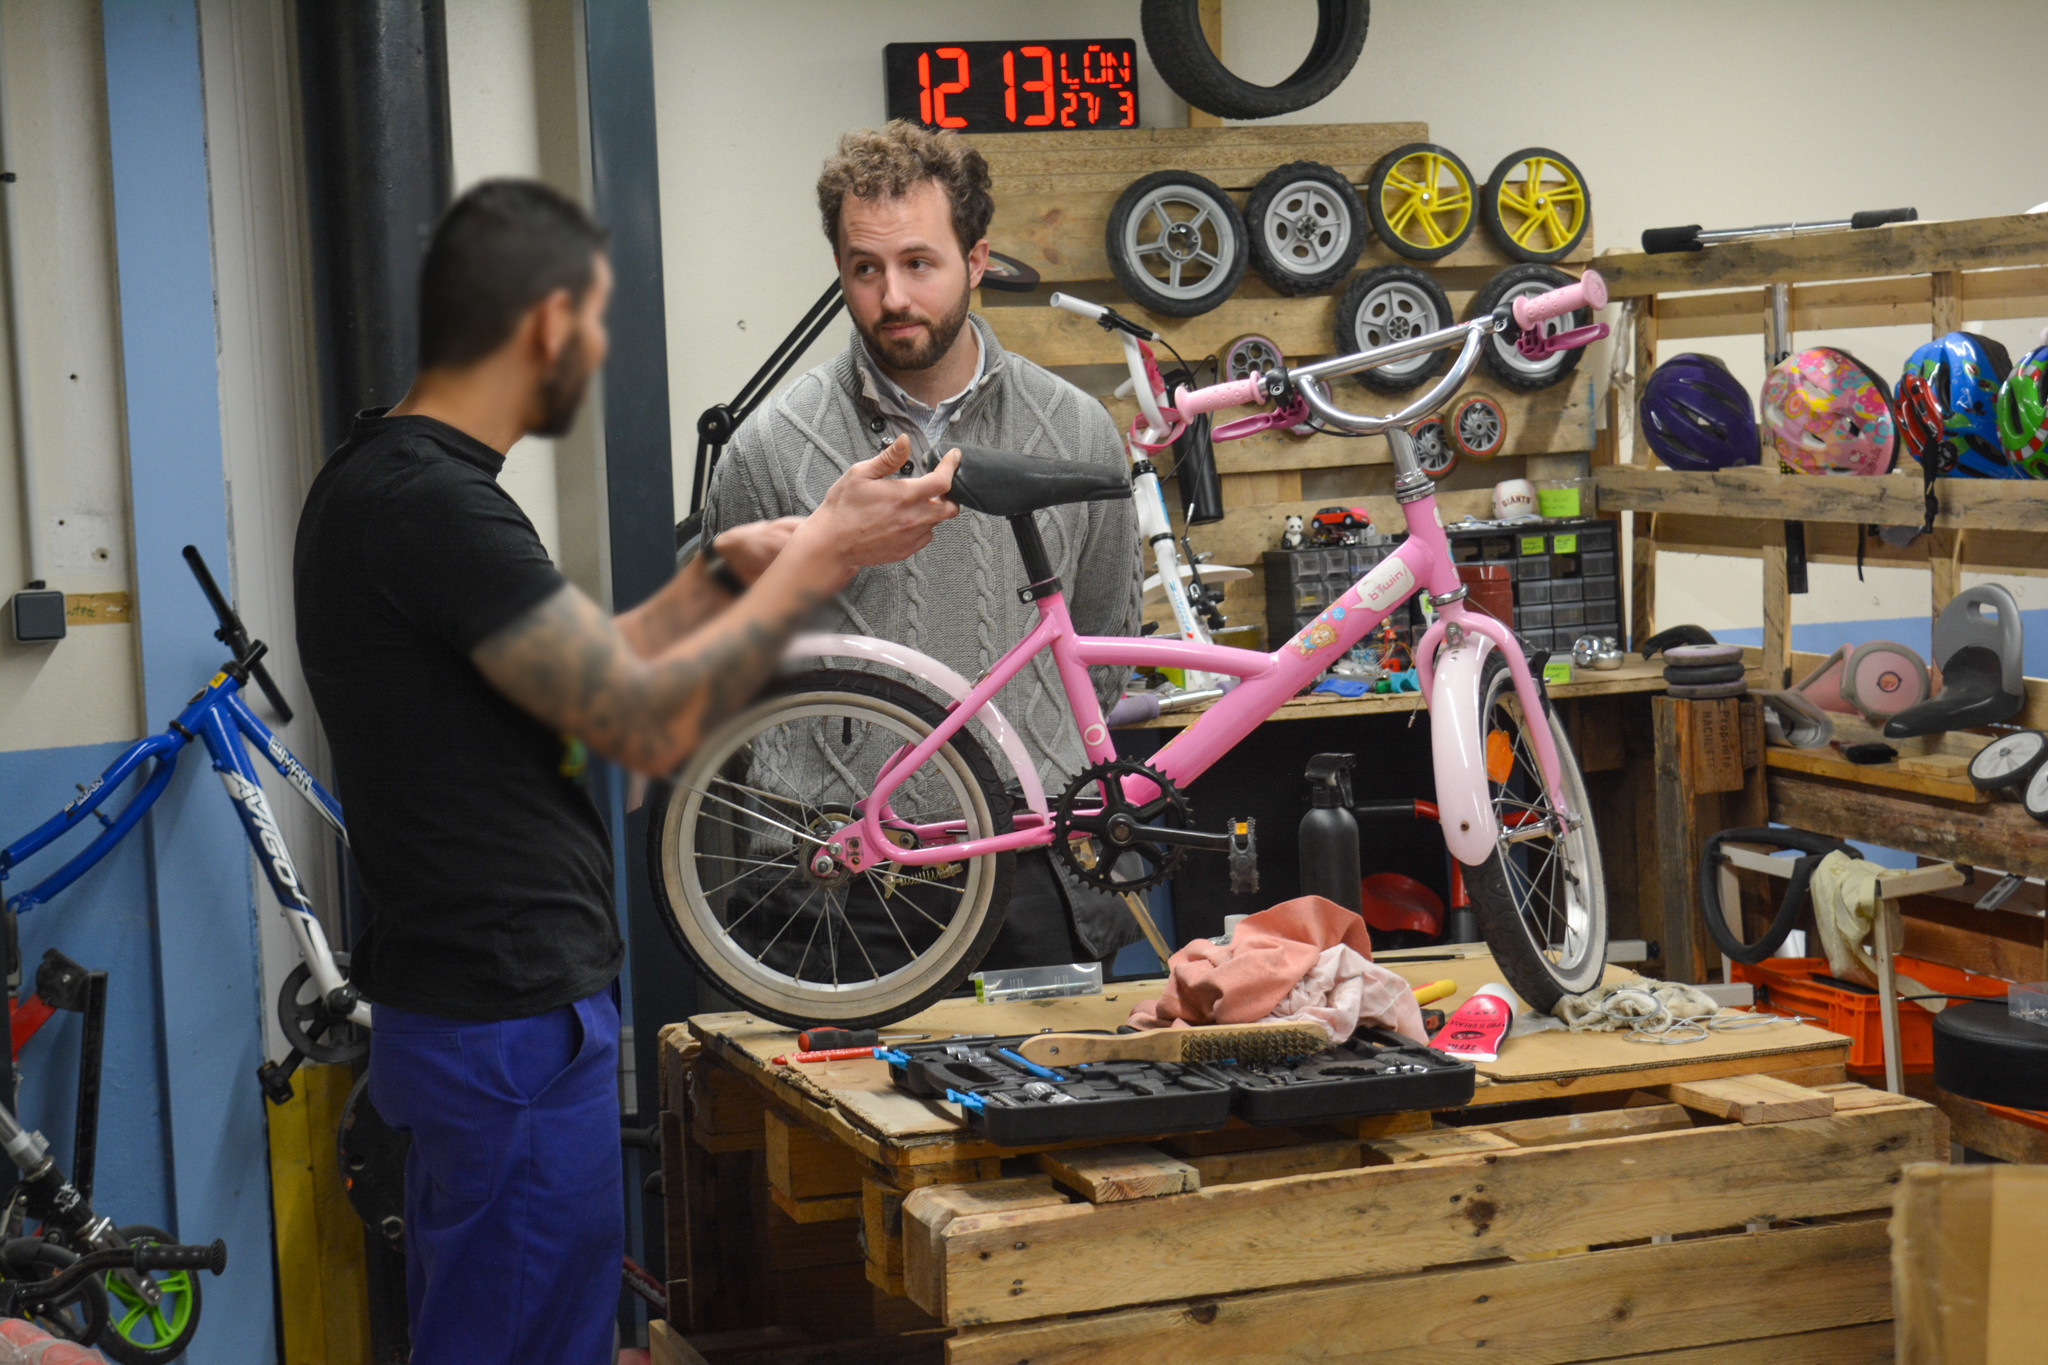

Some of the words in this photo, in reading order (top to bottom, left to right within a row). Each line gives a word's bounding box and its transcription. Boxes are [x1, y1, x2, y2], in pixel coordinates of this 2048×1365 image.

[918, 47, 970, 128] 12
[1002, 46, 1055, 126] 13
[1502, 495, 1531, 508] GIANTS
[230, 769, 298, 888] AVIGO
